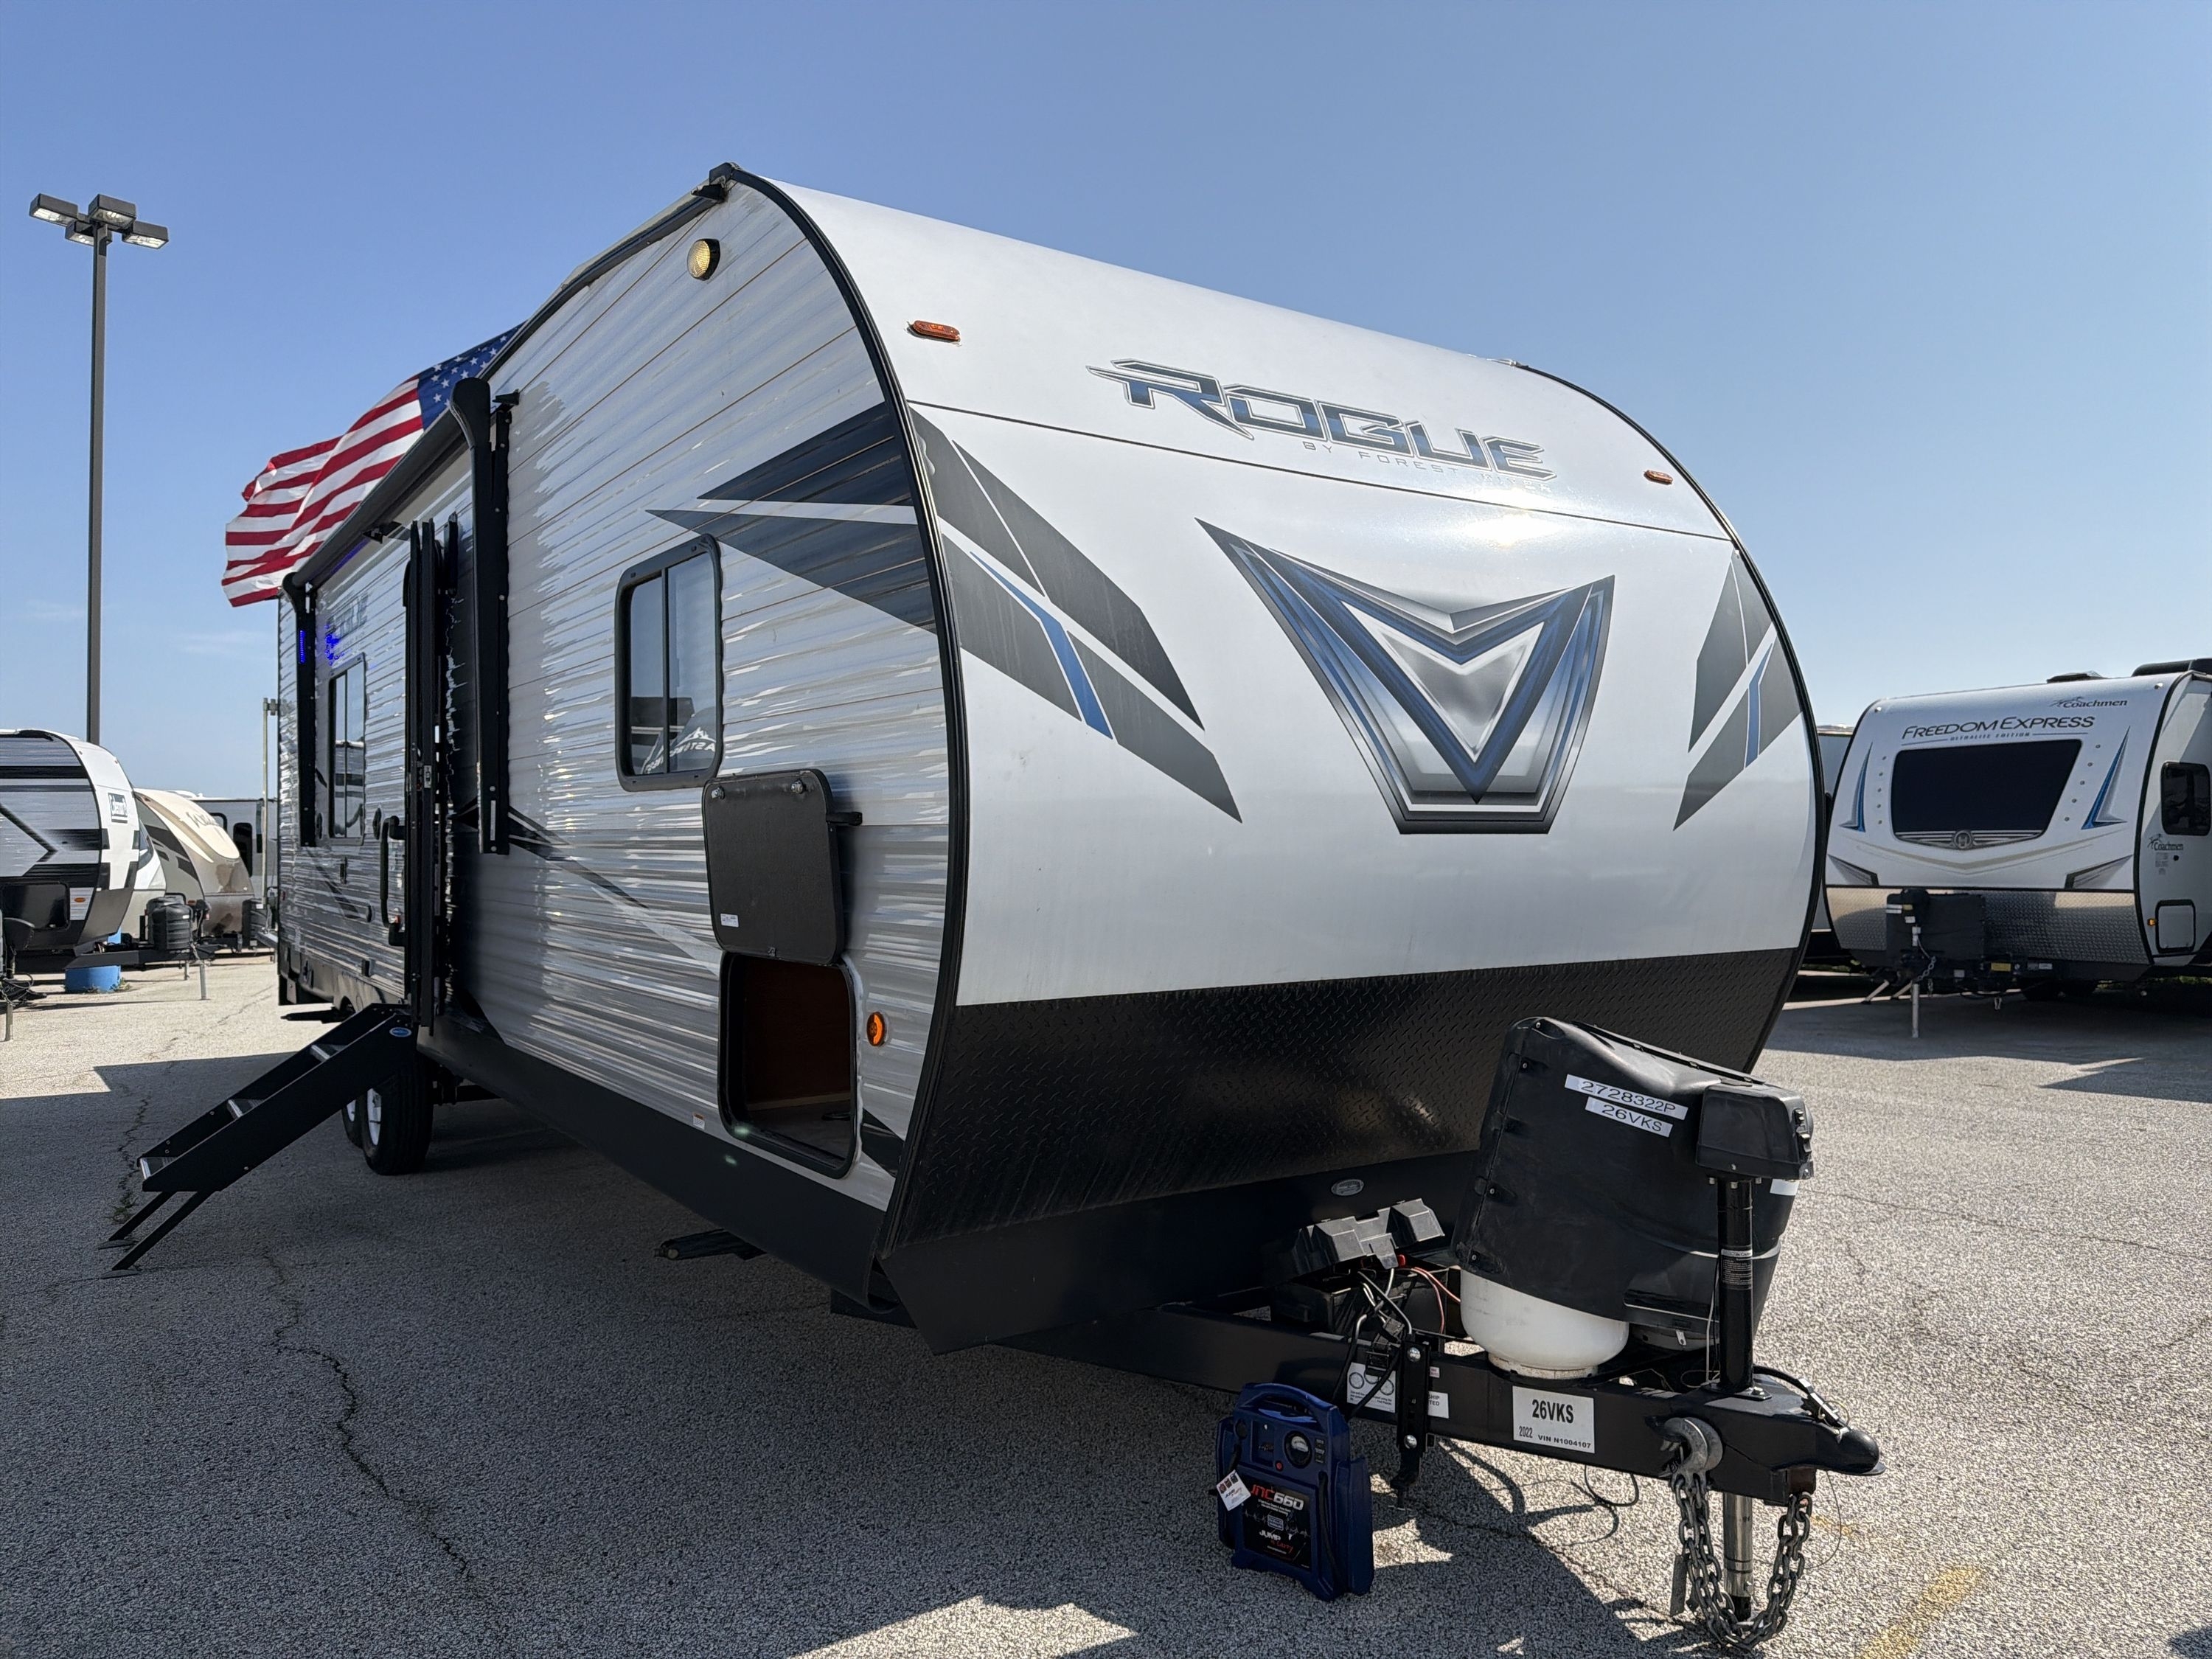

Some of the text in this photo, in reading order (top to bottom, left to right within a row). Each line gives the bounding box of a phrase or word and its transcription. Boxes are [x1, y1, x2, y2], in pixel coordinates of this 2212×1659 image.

[1086, 358, 1557, 481] ROGUE
[1302, 440, 1333, 453] BY
[1358, 451, 1459, 474] FOREST
[2062, 699, 2128, 709] Coachmen
[1902, 716, 2096, 740] FREEDOM EXPRESS
[1581, 1081, 1676, 1113] 2728322P
[1601, 1104, 1663, 1132] 26VKS
[1531, 1399, 1574, 1424] 26VKS
[1519, 1425, 1533, 1439] 2022
[1537, 1434, 1591, 1449] VIN N1004107
[1259, 1530, 1281, 1541] JUMP
